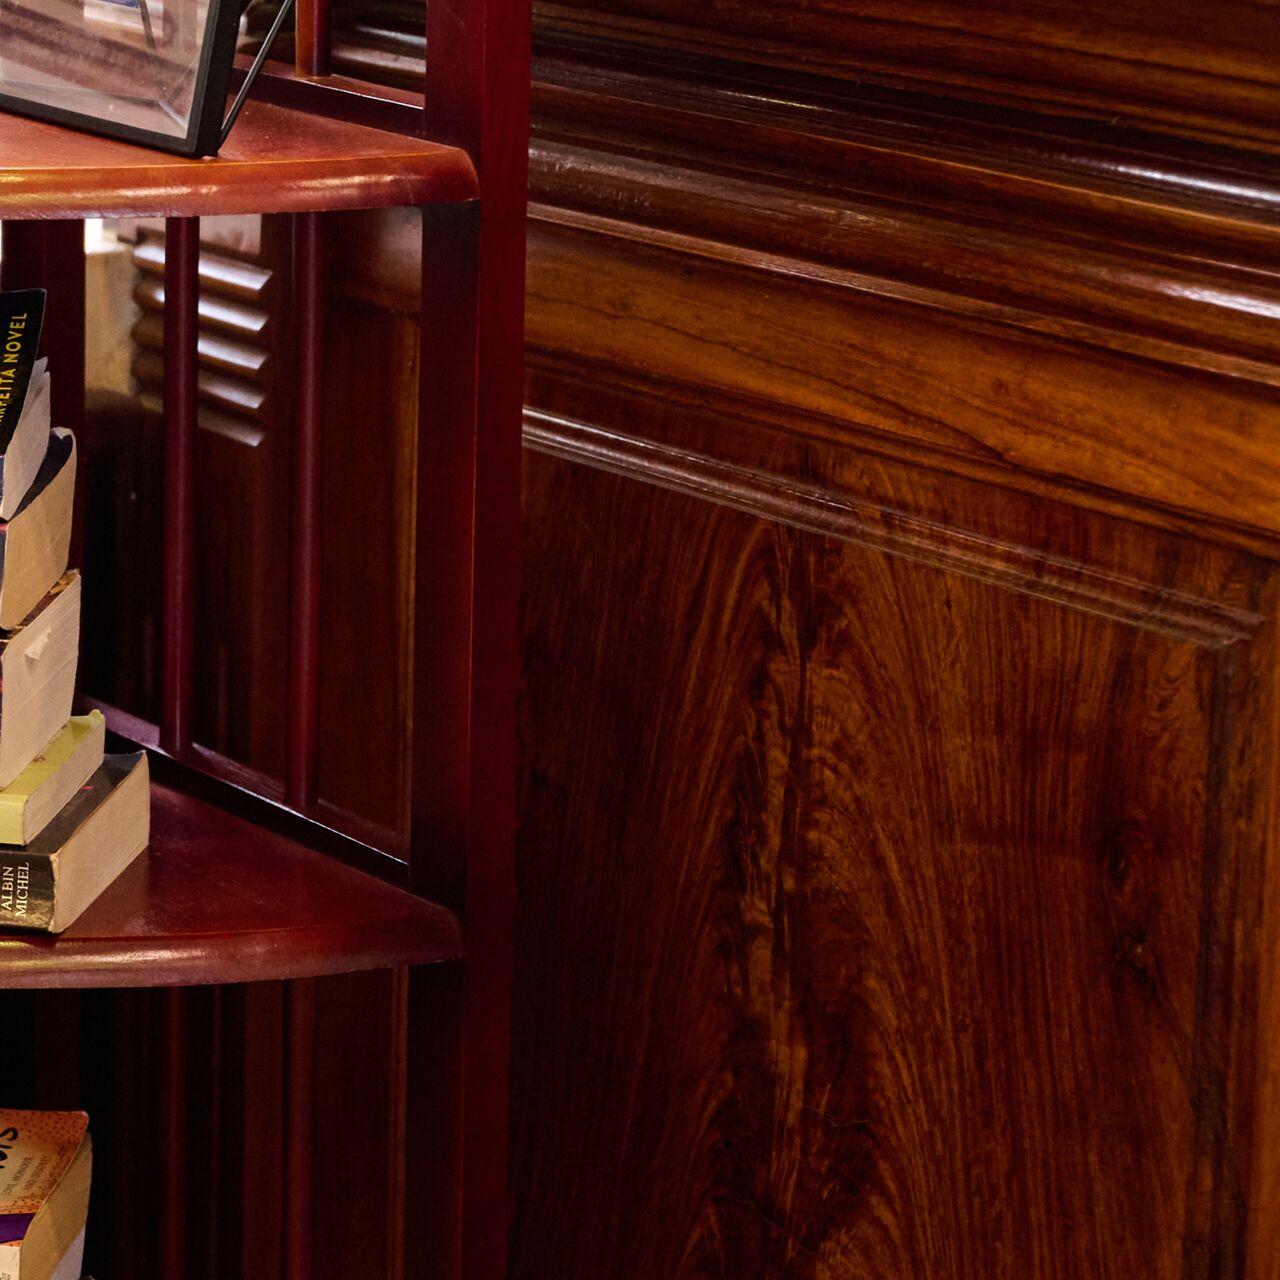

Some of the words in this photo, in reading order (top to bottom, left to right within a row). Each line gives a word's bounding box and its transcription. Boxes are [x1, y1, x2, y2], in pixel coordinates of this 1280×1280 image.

[2, 312, 29, 366] NOVEL
[0, 865, 15, 913] ALBIN
[16, 861, 30, 919] MICHEL
